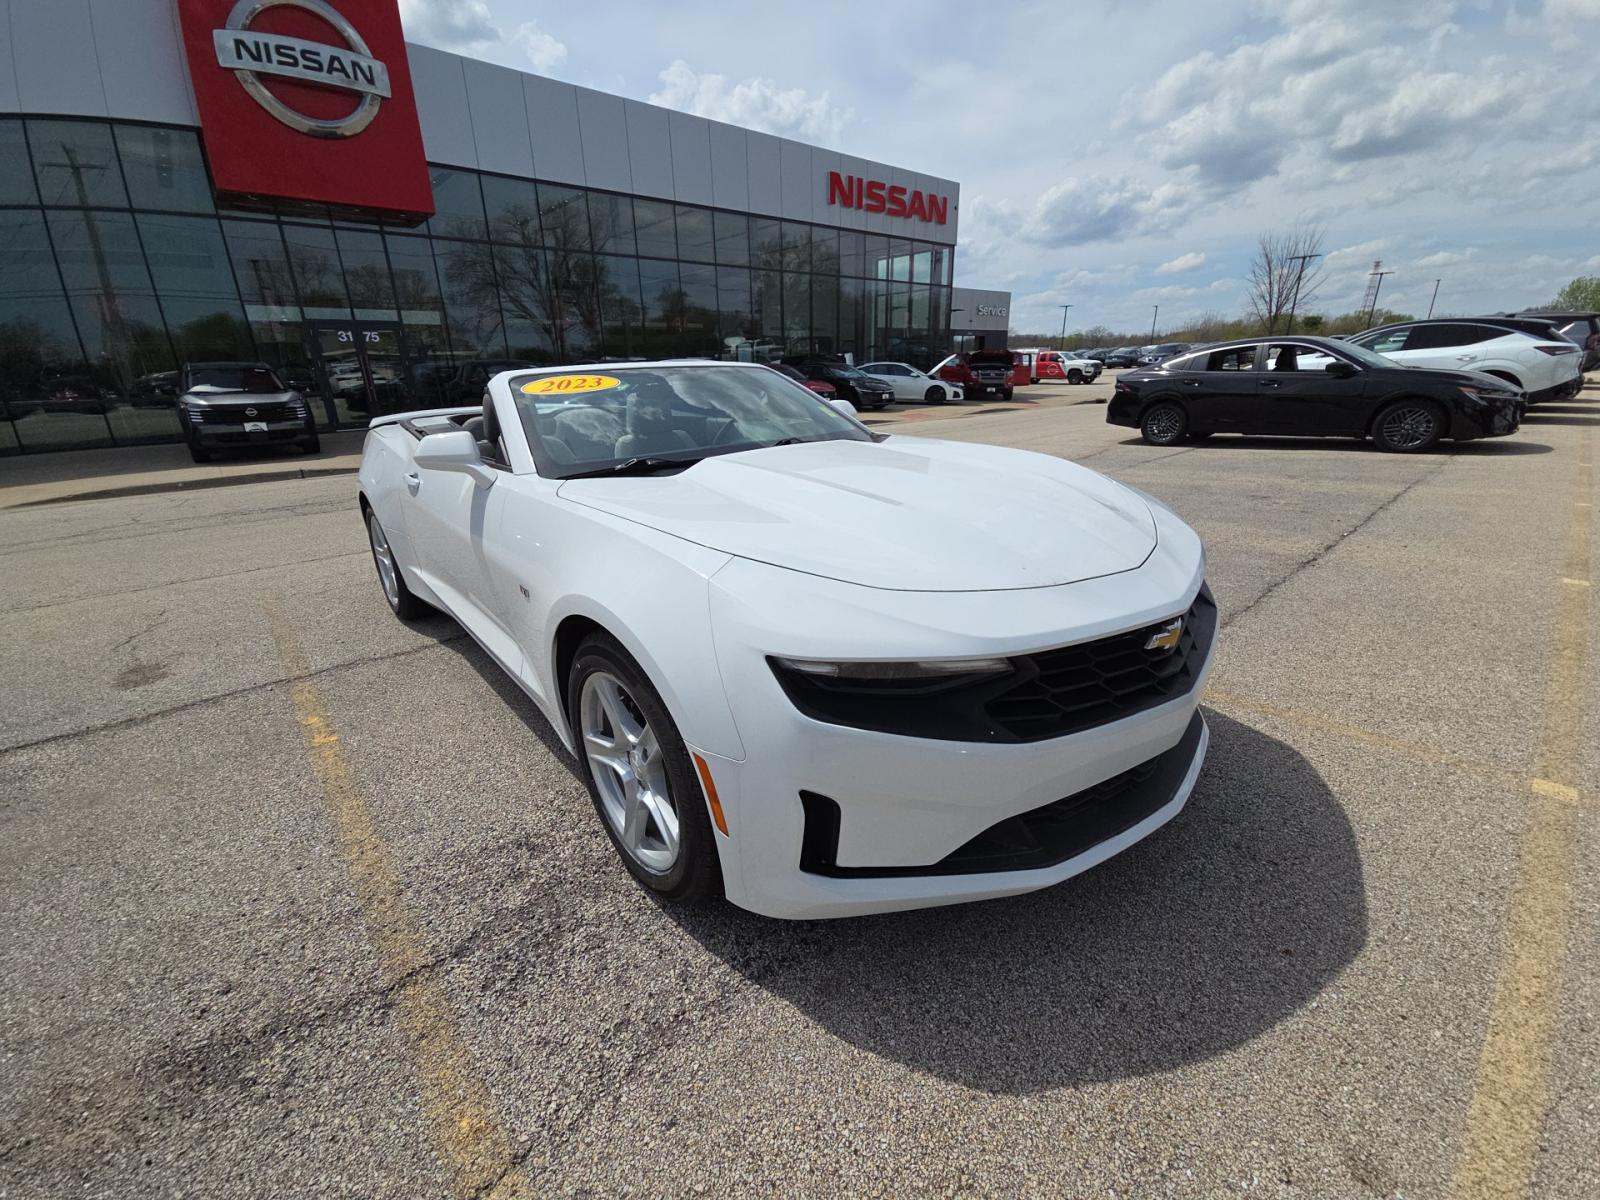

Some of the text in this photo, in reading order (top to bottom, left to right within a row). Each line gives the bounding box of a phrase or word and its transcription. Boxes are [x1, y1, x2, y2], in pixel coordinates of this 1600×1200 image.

[233, 38, 376, 86] NISSAN
[828, 171, 948, 225] NISSAN
[977, 304, 1008, 317] Service
[540, 377, 603, 393] 2023
